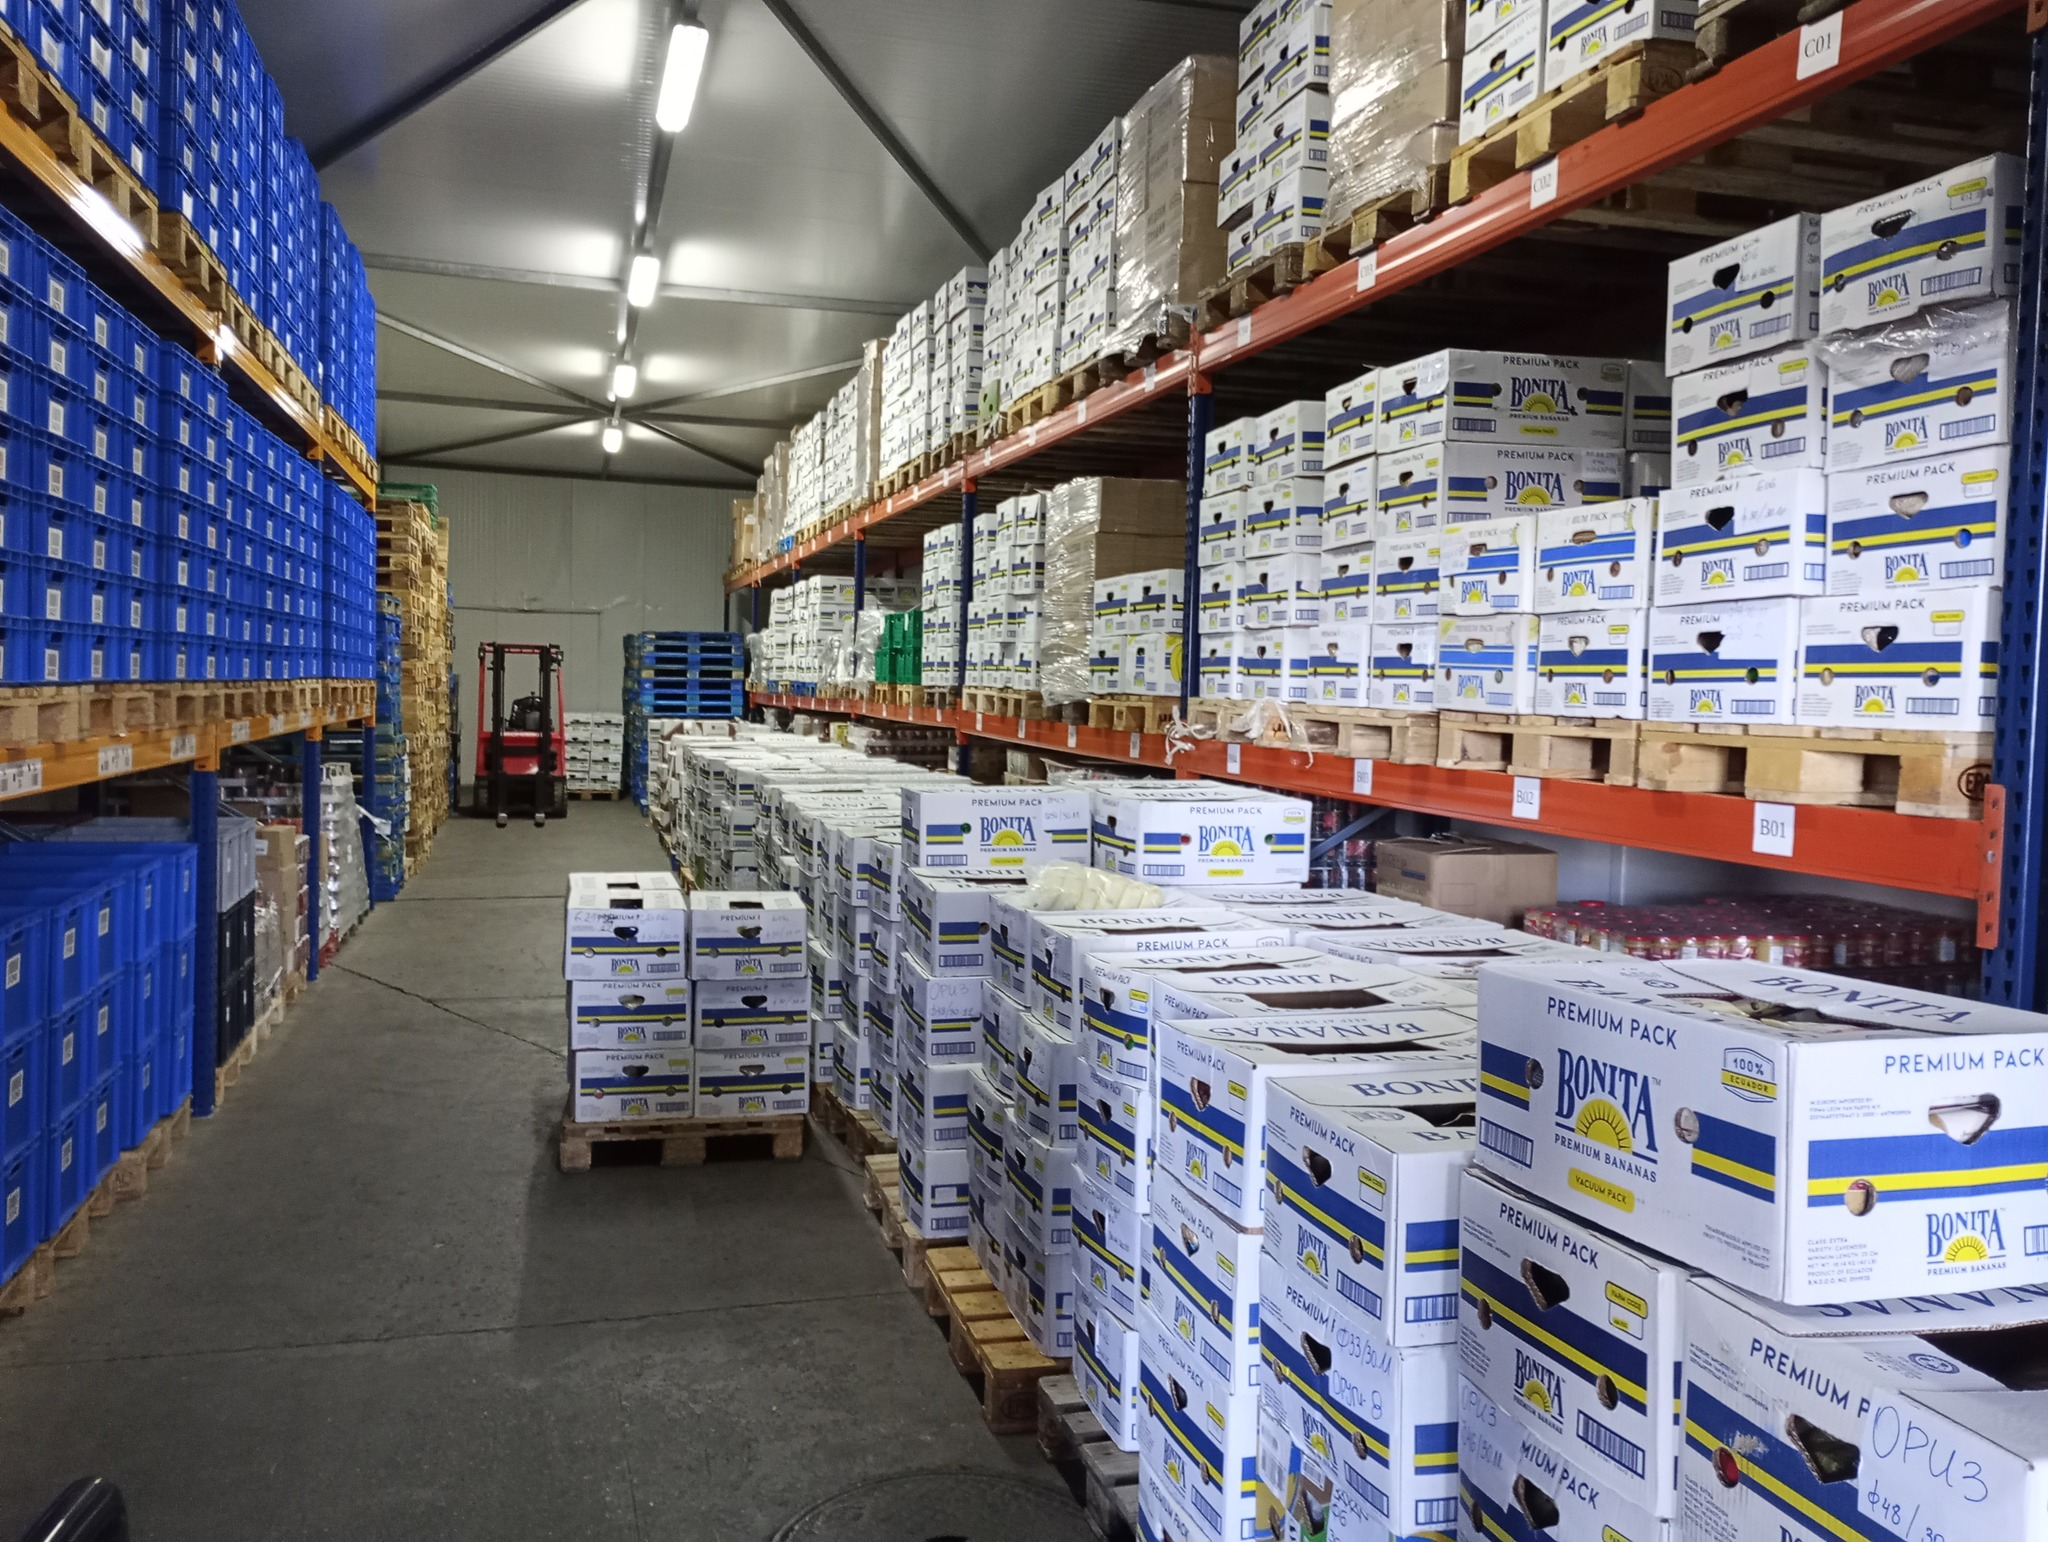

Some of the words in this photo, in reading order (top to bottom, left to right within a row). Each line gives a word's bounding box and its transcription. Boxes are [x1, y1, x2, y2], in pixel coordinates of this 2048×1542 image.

[1580, 25, 1608, 56] BONITA
[1803, 34, 1834, 59] C01
[1532, 172, 1554, 193] C02
[1856, 192, 1910, 217] PREMIUM
[1911, 177, 1944, 198] PACK
[1700, 242, 1739, 266] PREMIUM
[1868, 272, 1910, 307] BONITA
[1709, 317, 1742, 346] BONITA
[1502, 356, 1551, 368] PREMIUM
[1553, 358, 1580, 370] PACK
[1702, 364, 1746, 382] PREMIUM
[1748, 357, 1774, 369] PACK
[1510, 377, 1569, 409] BONITA
[1885, 416, 1929, 448] BONITA
[1497, 450, 1546, 462] PREMIUM
[1547, 451, 1575, 462] PACK
[1718, 436, 1753, 465] BONITA
[1866, 468, 1920, 486] PREMIUM
[1923, 462, 1956, 475] PACK
[1504, 470, 1566, 503] BONITA
[1690, 483, 1734, 499] PREMIUM
[1504, 505, 1535, 513] PREMIUM
[1589, 512, 1609, 523] PACK
[1701, 558, 1735, 583] BONITA
[1885, 553, 1929, 580] BONITA
[1461, 580, 1489, 604] BONITA
[1562, 570, 1596, 597] BONITA
[1839, 601, 1892, 613] PREMIUM
[1894, 598, 1925, 610] PACK
[1556, 615, 1585, 626] PREMIUM
[1586, 615, 1606, 625] PACK
[1679, 615, 1721, 626] PREMIUM
[1457, 675, 1485, 700] BONITA
[1564, 682, 1588, 705] BONITA
[1854, 685, 1895, 710] BONITA
[1690, 689, 1722, 711] BONITA
[972, 798, 1016, 807] PREMIUM
[1516, 789, 1534, 805] B02
[1190, 807, 1235, 815] PREMIUM
[1238, 806, 1263, 815] PACK
[979, 816, 1037, 843] BONITA
[1759, 813, 1786, 838] B01
[1198, 825, 1255, 852] BONITA
[1212, 892, 1344, 902] BANANAS
[720, 914, 755, 922] PREMIUM
[1079, 916, 1196, 928] BONITA
[1282, 910, 1395, 921] BONITA
[1136, 940, 1194, 952] PREMIUM
[1198, 938, 1230, 950] PACK
[1327, 947, 1355, 962] PREMIUM
[611, 958, 640, 973] BONITA
[735, 958, 763, 974] BONITA
[1135, 952, 1265, 966] BONITA
[602, 982, 640, 990] PREMIUM
[1093, 965, 1117, 984] PREMIUM
[1116, 974, 1132, 985] PACK
[1208, 973, 1353, 987] BONITA
[725, 985, 760, 993] PREMIUM
[1751, 976, 1973, 1025] BONITA
[1164, 993, 1191, 1015] PREMIUM
[1191, 1007, 1209, 1020] PACK
[618, 1026, 647, 1041] BONITA
[1208, 1021, 1427, 1040] BANANAS
[1548, 996, 1623, 1035] PREMIUM
[1630, 1018, 1678, 1050] PACK
[740, 1028, 769, 1043] BONITA
[606, 1053, 641, 1061] PREMIUM
[642, 1053, 665, 1061] PACK
[723, 1052, 758, 1060] PREMIUM
[758, 1051, 781, 1059] PACK
[1177, 1040, 1207, 1066] PREMIUM
[1208, 1053, 1226, 1074] PACK
[1732, 1057, 1765, 1076] 100%
[1884, 1052, 1985, 1075] PREMIUM
[1994, 1047, 2046, 1069] PACK
[1108, 1080, 1122, 1097] PACK
[1730, 1075, 1769, 1093] ECUADOR
[620, 1097, 649, 1113] BONITA
[738, 1096, 767, 1111] BONITA
[1555, 1047, 1658, 1153] BONITA
[1289, 1106, 1328, 1141] PREMIUM
[1330, 1131, 1355, 1158] PACK
[1185, 1138, 1209, 1184] BONITA
[1554, 1132, 1601, 1161] PREMIUM
[1604, 1152, 1658, 1184] BANANAS
[1575, 1174, 1606, 1196] VACUUM
[1607, 1188, 1628, 1205] PACK
[1170, 1193, 1197, 1227] PREMIUM
[1198, 1220, 1215, 1244] PACK
[1499, 1203, 1557, 1248] PREMIUM
[1562, 1232, 1598, 1270] PACK
[1926, 1207, 2006, 1259] BONITA
[1297, 1223, 1330, 1279] BONITA
[1928, 1265, 1968, 1276] PREMIUM
[1971, 1261, 2007, 1273] BANANAS
[1285, 1285, 1329, 1328] PREMIUM
[1612, 1289, 1626, 1304] FARM
[1173, 1295, 1197, 1348] BONITA
[1157, 1333, 1187, 1371] PREMIUM
[1187, 1364, 1205, 1392] PACK
[1749, 1337, 1850, 1411] PREMIUM
[1513, 1347, 1565, 1419] BONITA
[1301, 1405, 1339, 1466] BONITA
[1163, 1436, 1188, 1490] BONITA
[1559, 1472, 1600, 1511] PACK
[1173, 1508, 1191, 1541] PACK
